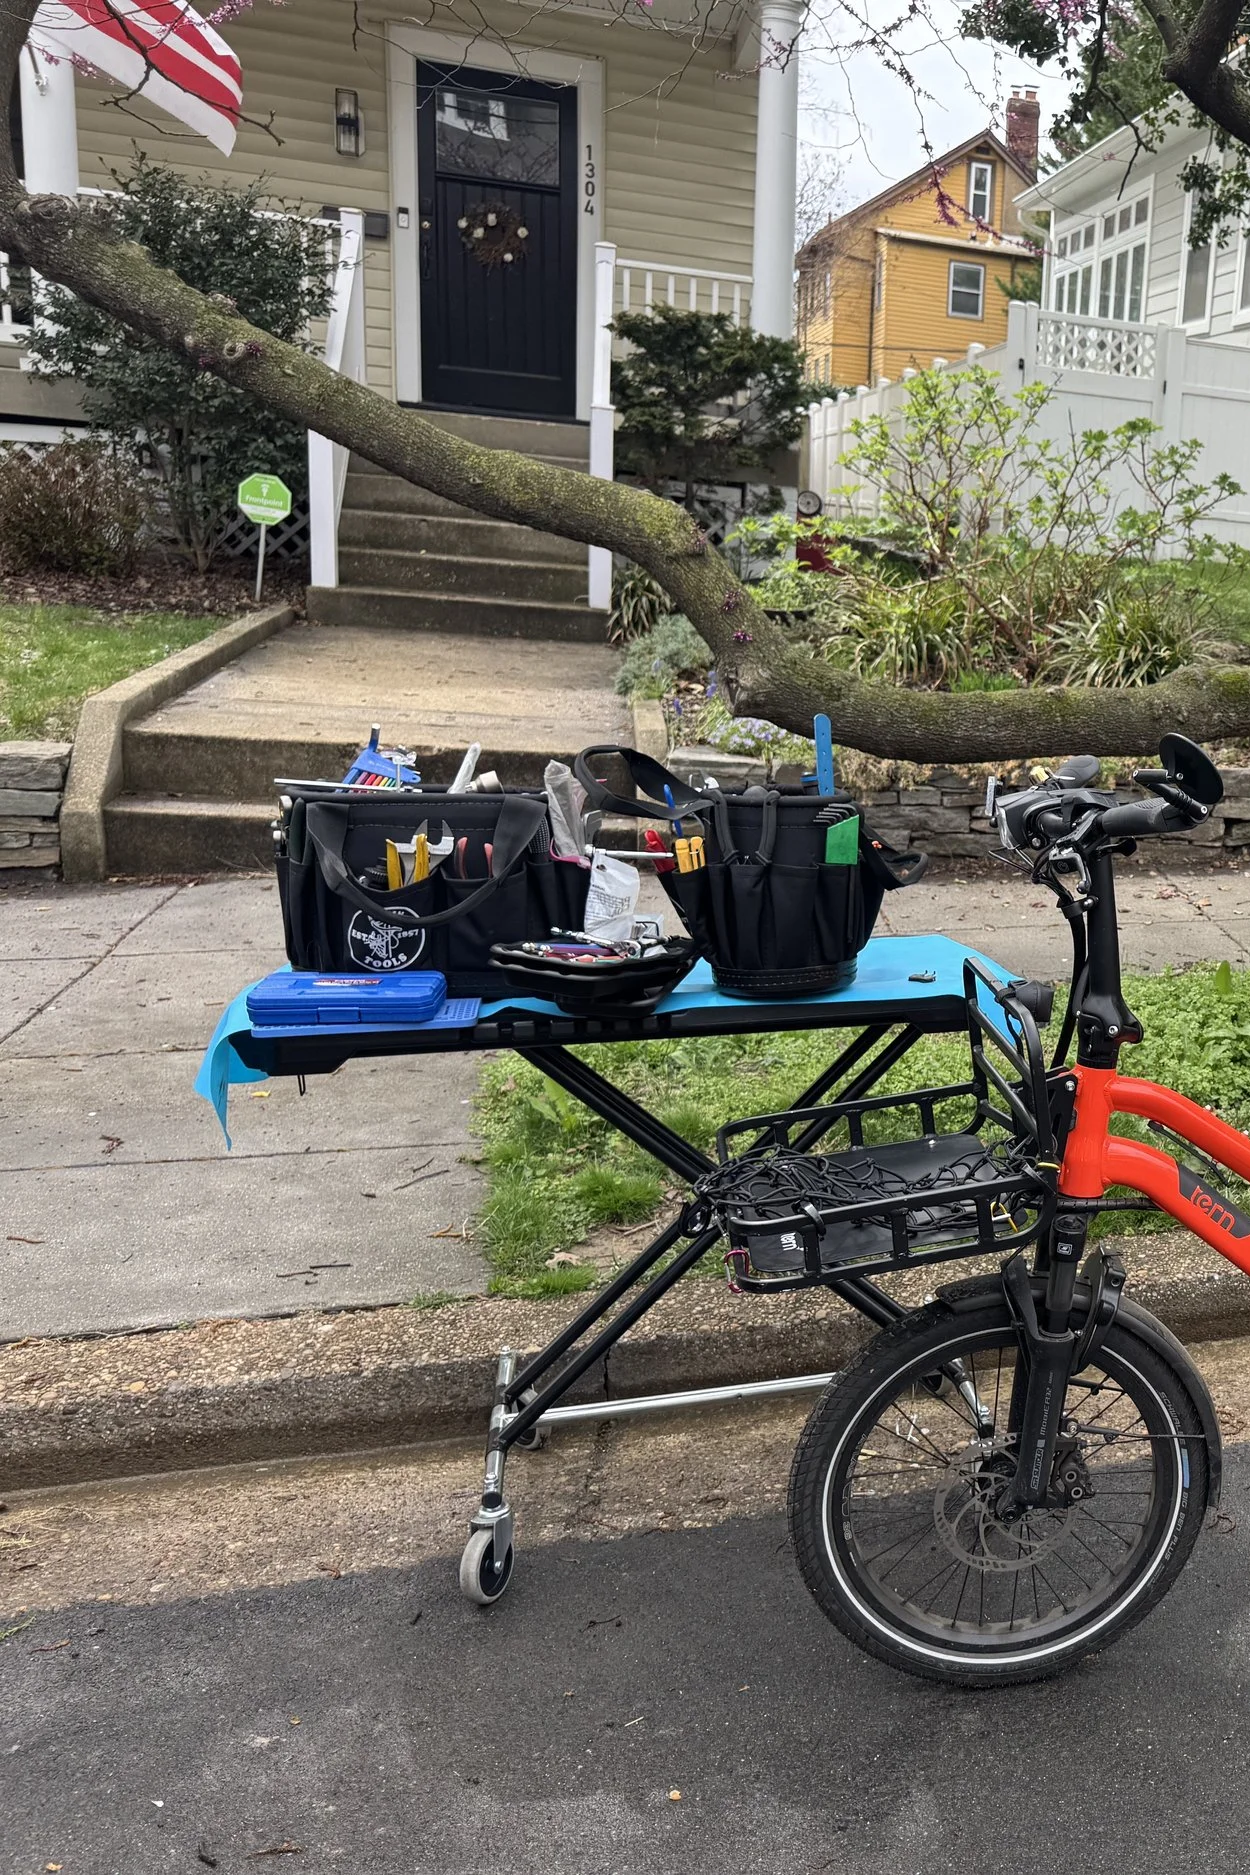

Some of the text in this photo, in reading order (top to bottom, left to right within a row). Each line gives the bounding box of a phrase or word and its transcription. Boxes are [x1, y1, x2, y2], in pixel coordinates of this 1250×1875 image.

[584, 144, 596, 216] 1304
[364, 952, 407, 968] TOOLS
[1190, 1184, 1236, 1232] tern
[1164, 1535, 1179, 1561] PLUS
